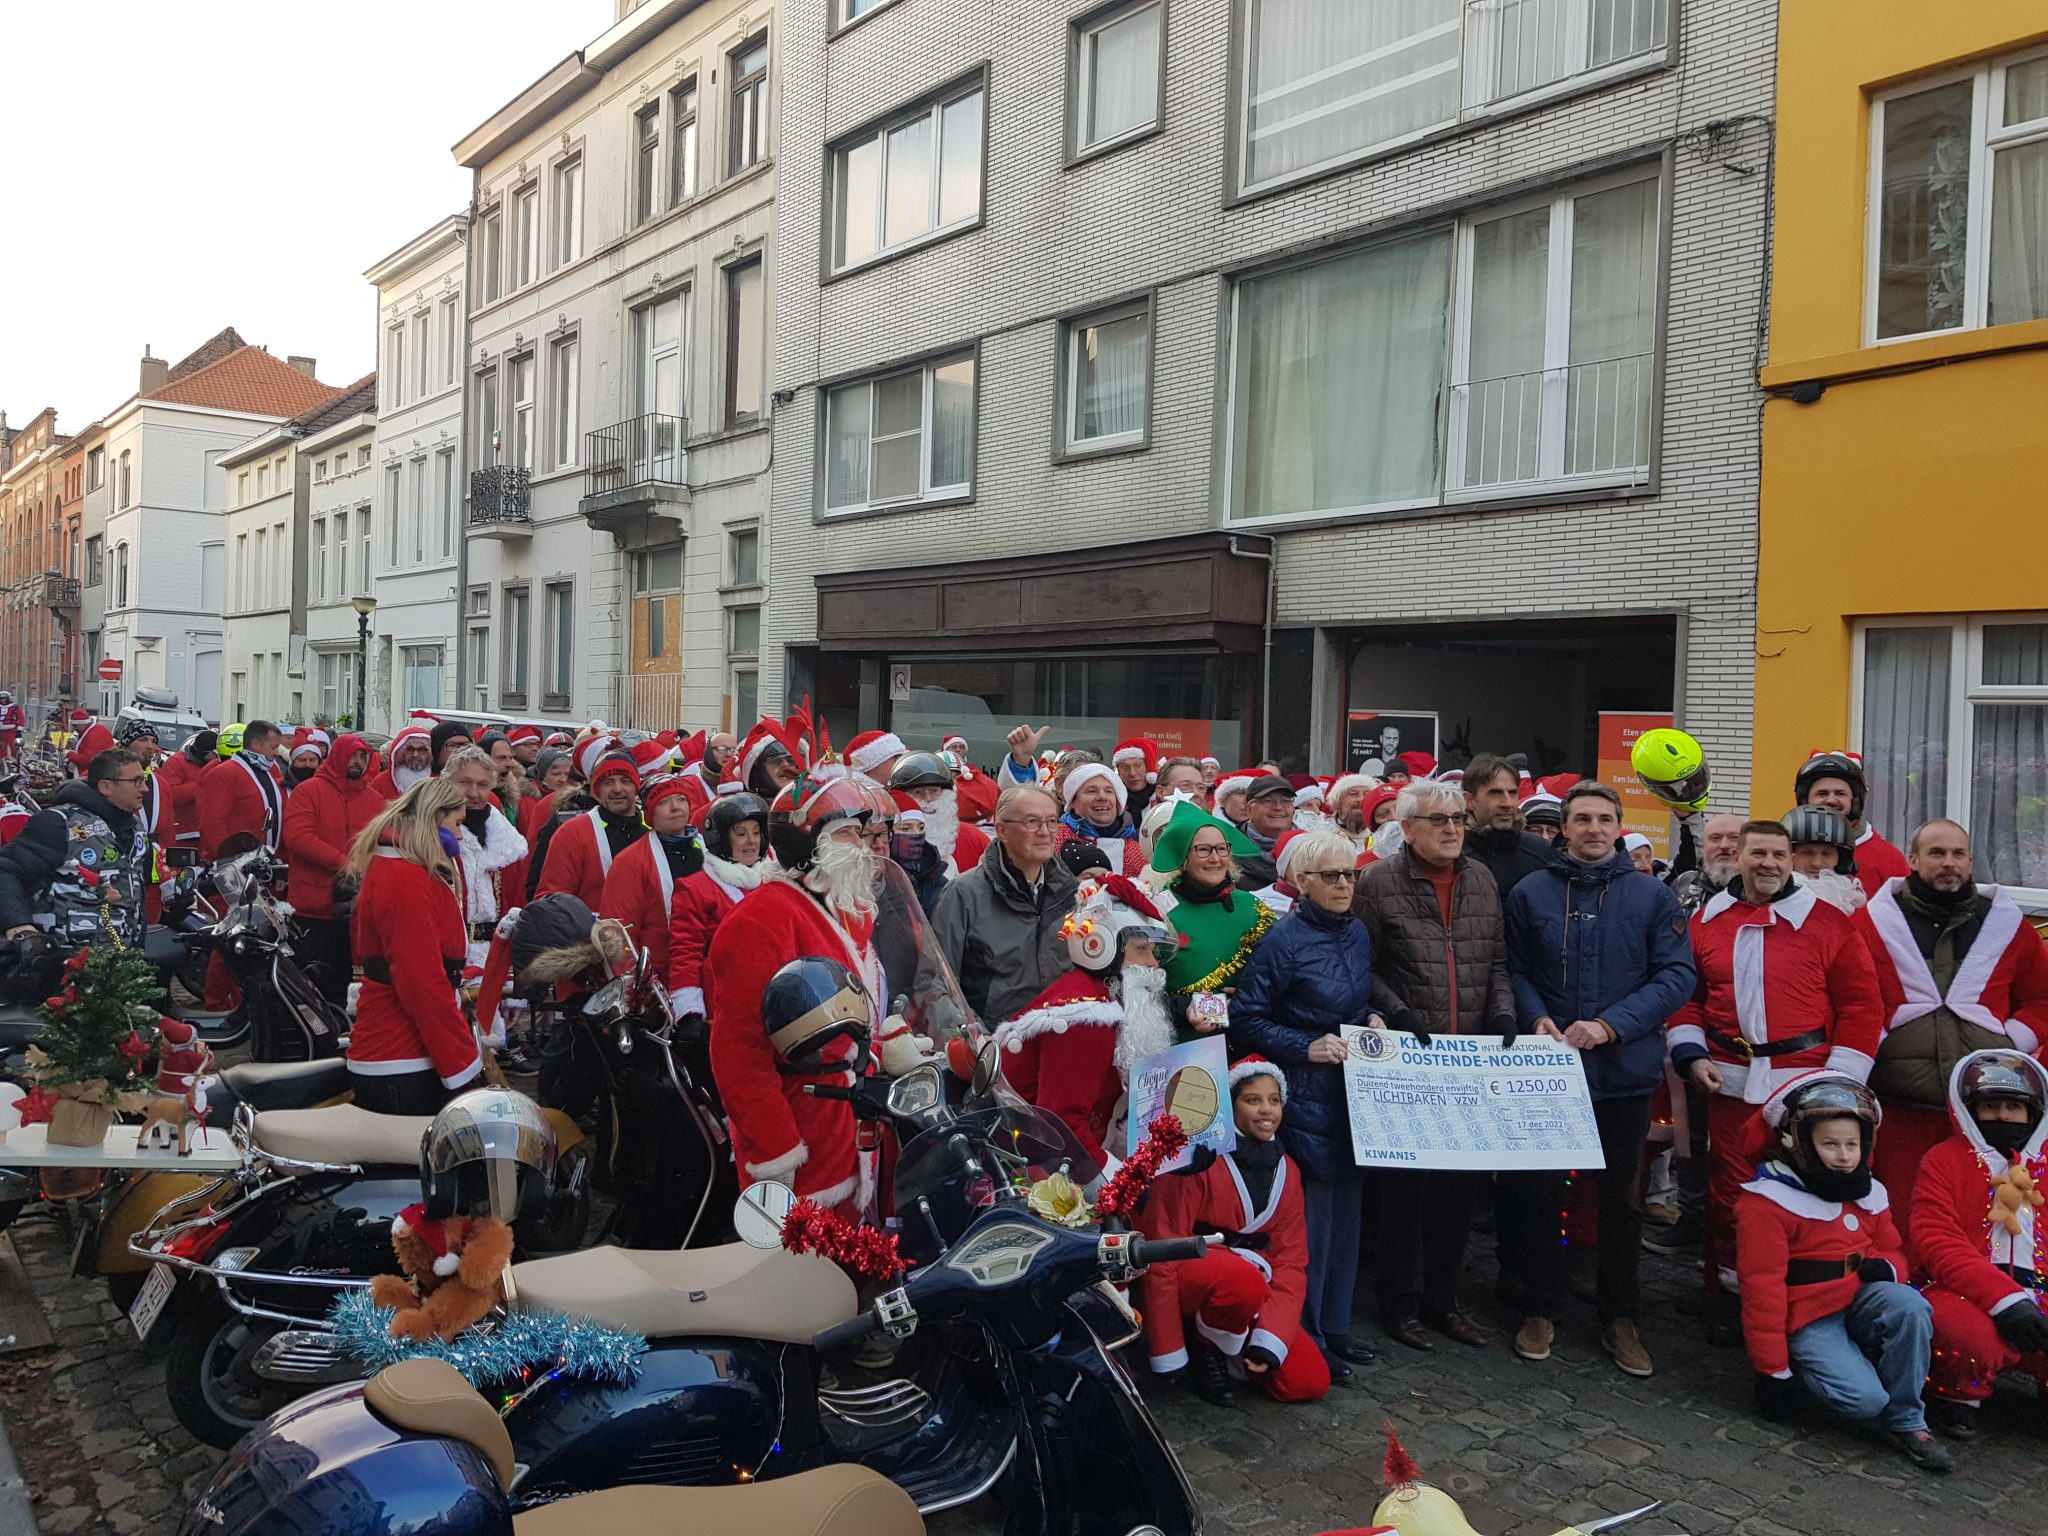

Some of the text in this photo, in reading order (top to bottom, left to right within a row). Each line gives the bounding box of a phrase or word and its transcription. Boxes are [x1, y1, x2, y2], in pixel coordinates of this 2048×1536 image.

[1623, 728, 1639, 737] Eten
[1613, 775, 1626, 783] Een
[1621, 822, 1665, 833] Vriendschap
[1481, 1044, 1554, 1052] INTERNATIONAL
[1401, 1052, 1575, 1067] OOSTENDE-NOORDZEE
[1357, 1079, 1480, 1095] Duizend tweehonderd envijftig
[1490, 1079, 1567, 1096] € 1250,00
[1373, 1090, 1447, 1105] LICHTBAKEN
[1528, 1120, 1542, 1128] dec
[1544, 1120, 1563, 1128] 2022
[1364, 1149, 1417, 1161] KIWANIS
